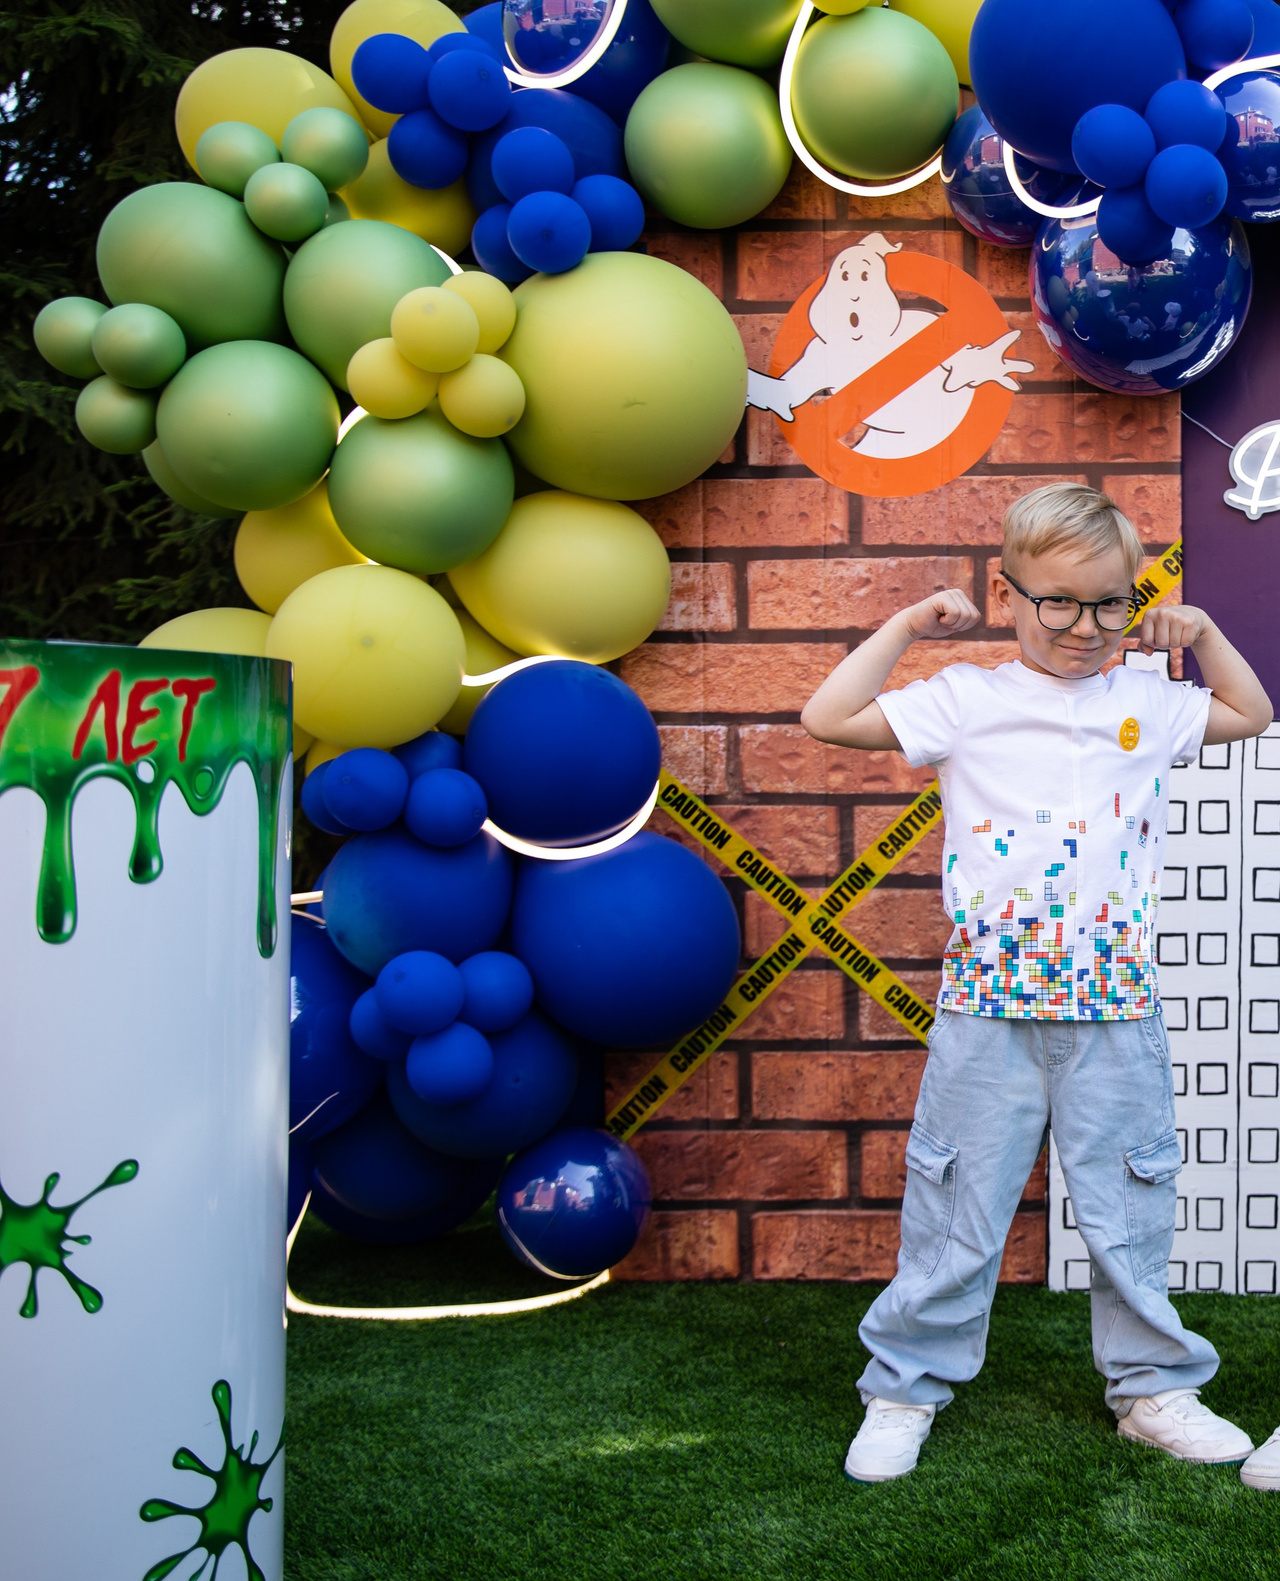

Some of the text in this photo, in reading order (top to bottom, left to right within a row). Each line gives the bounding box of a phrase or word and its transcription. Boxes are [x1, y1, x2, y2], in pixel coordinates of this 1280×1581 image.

[0, 665, 216, 765] 7 ЛЕТ
[660, 784, 935, 1033] CAUTION CAUTION CAUTION CAUTI
[670, 1004, 737, 1073] CAUTION
[738, 933, 806, 1003] CAUTION
[877, 790, 942, 860] CAUTION
